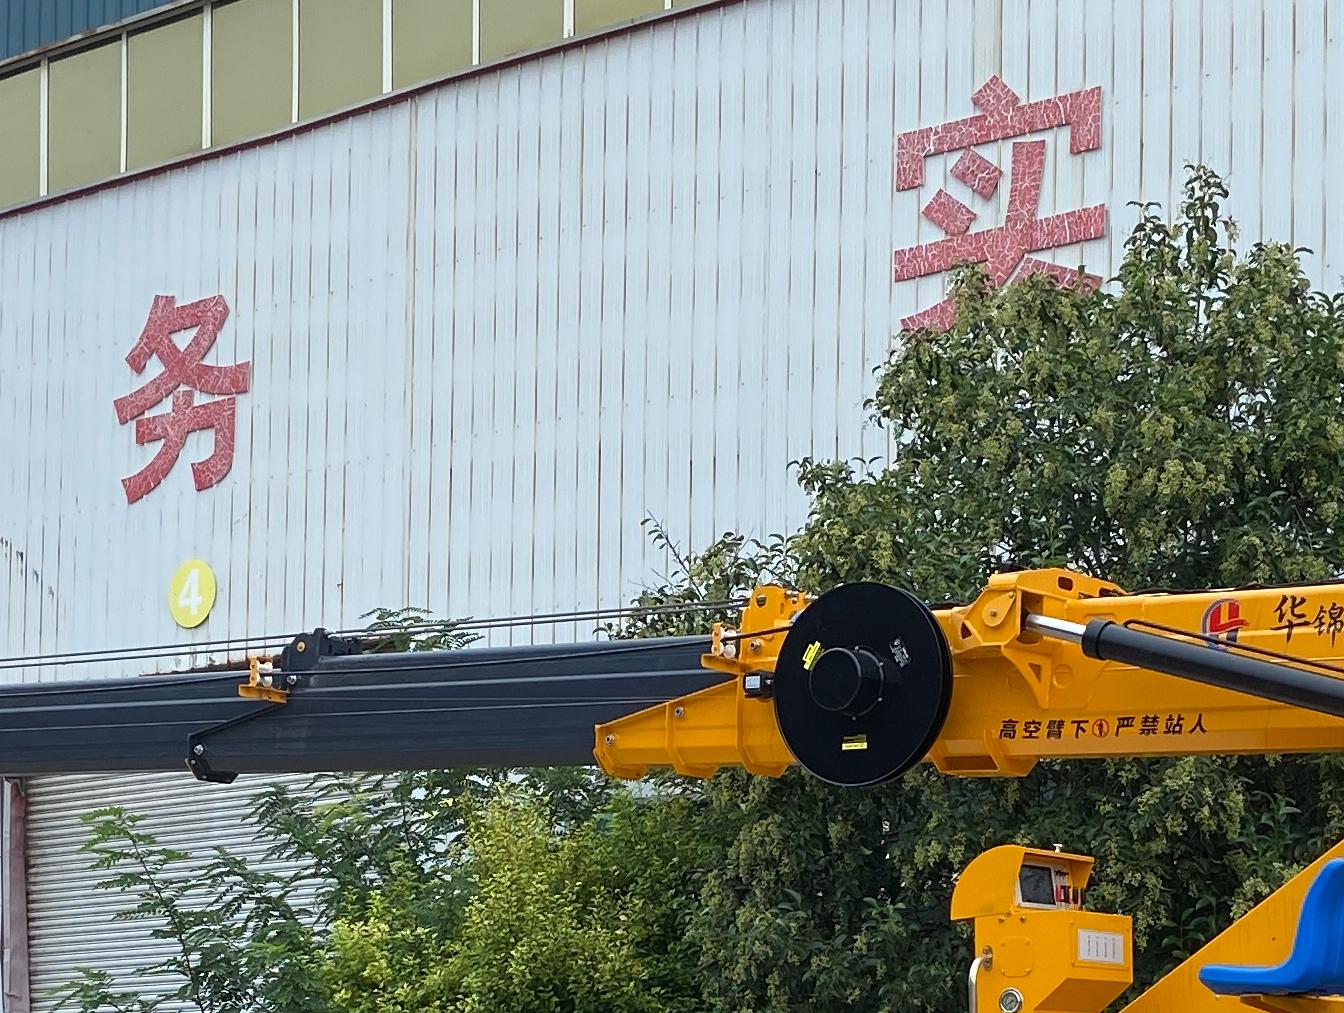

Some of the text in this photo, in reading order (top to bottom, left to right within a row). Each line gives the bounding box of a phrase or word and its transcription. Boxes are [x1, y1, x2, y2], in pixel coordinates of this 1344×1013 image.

[114, 294, 250, 504] 务
[894, 74, 1107, 332] 实
[178, 568, 202, 615] 4
[998, 713, 1208, 740] 高空臂下 严禁站人
